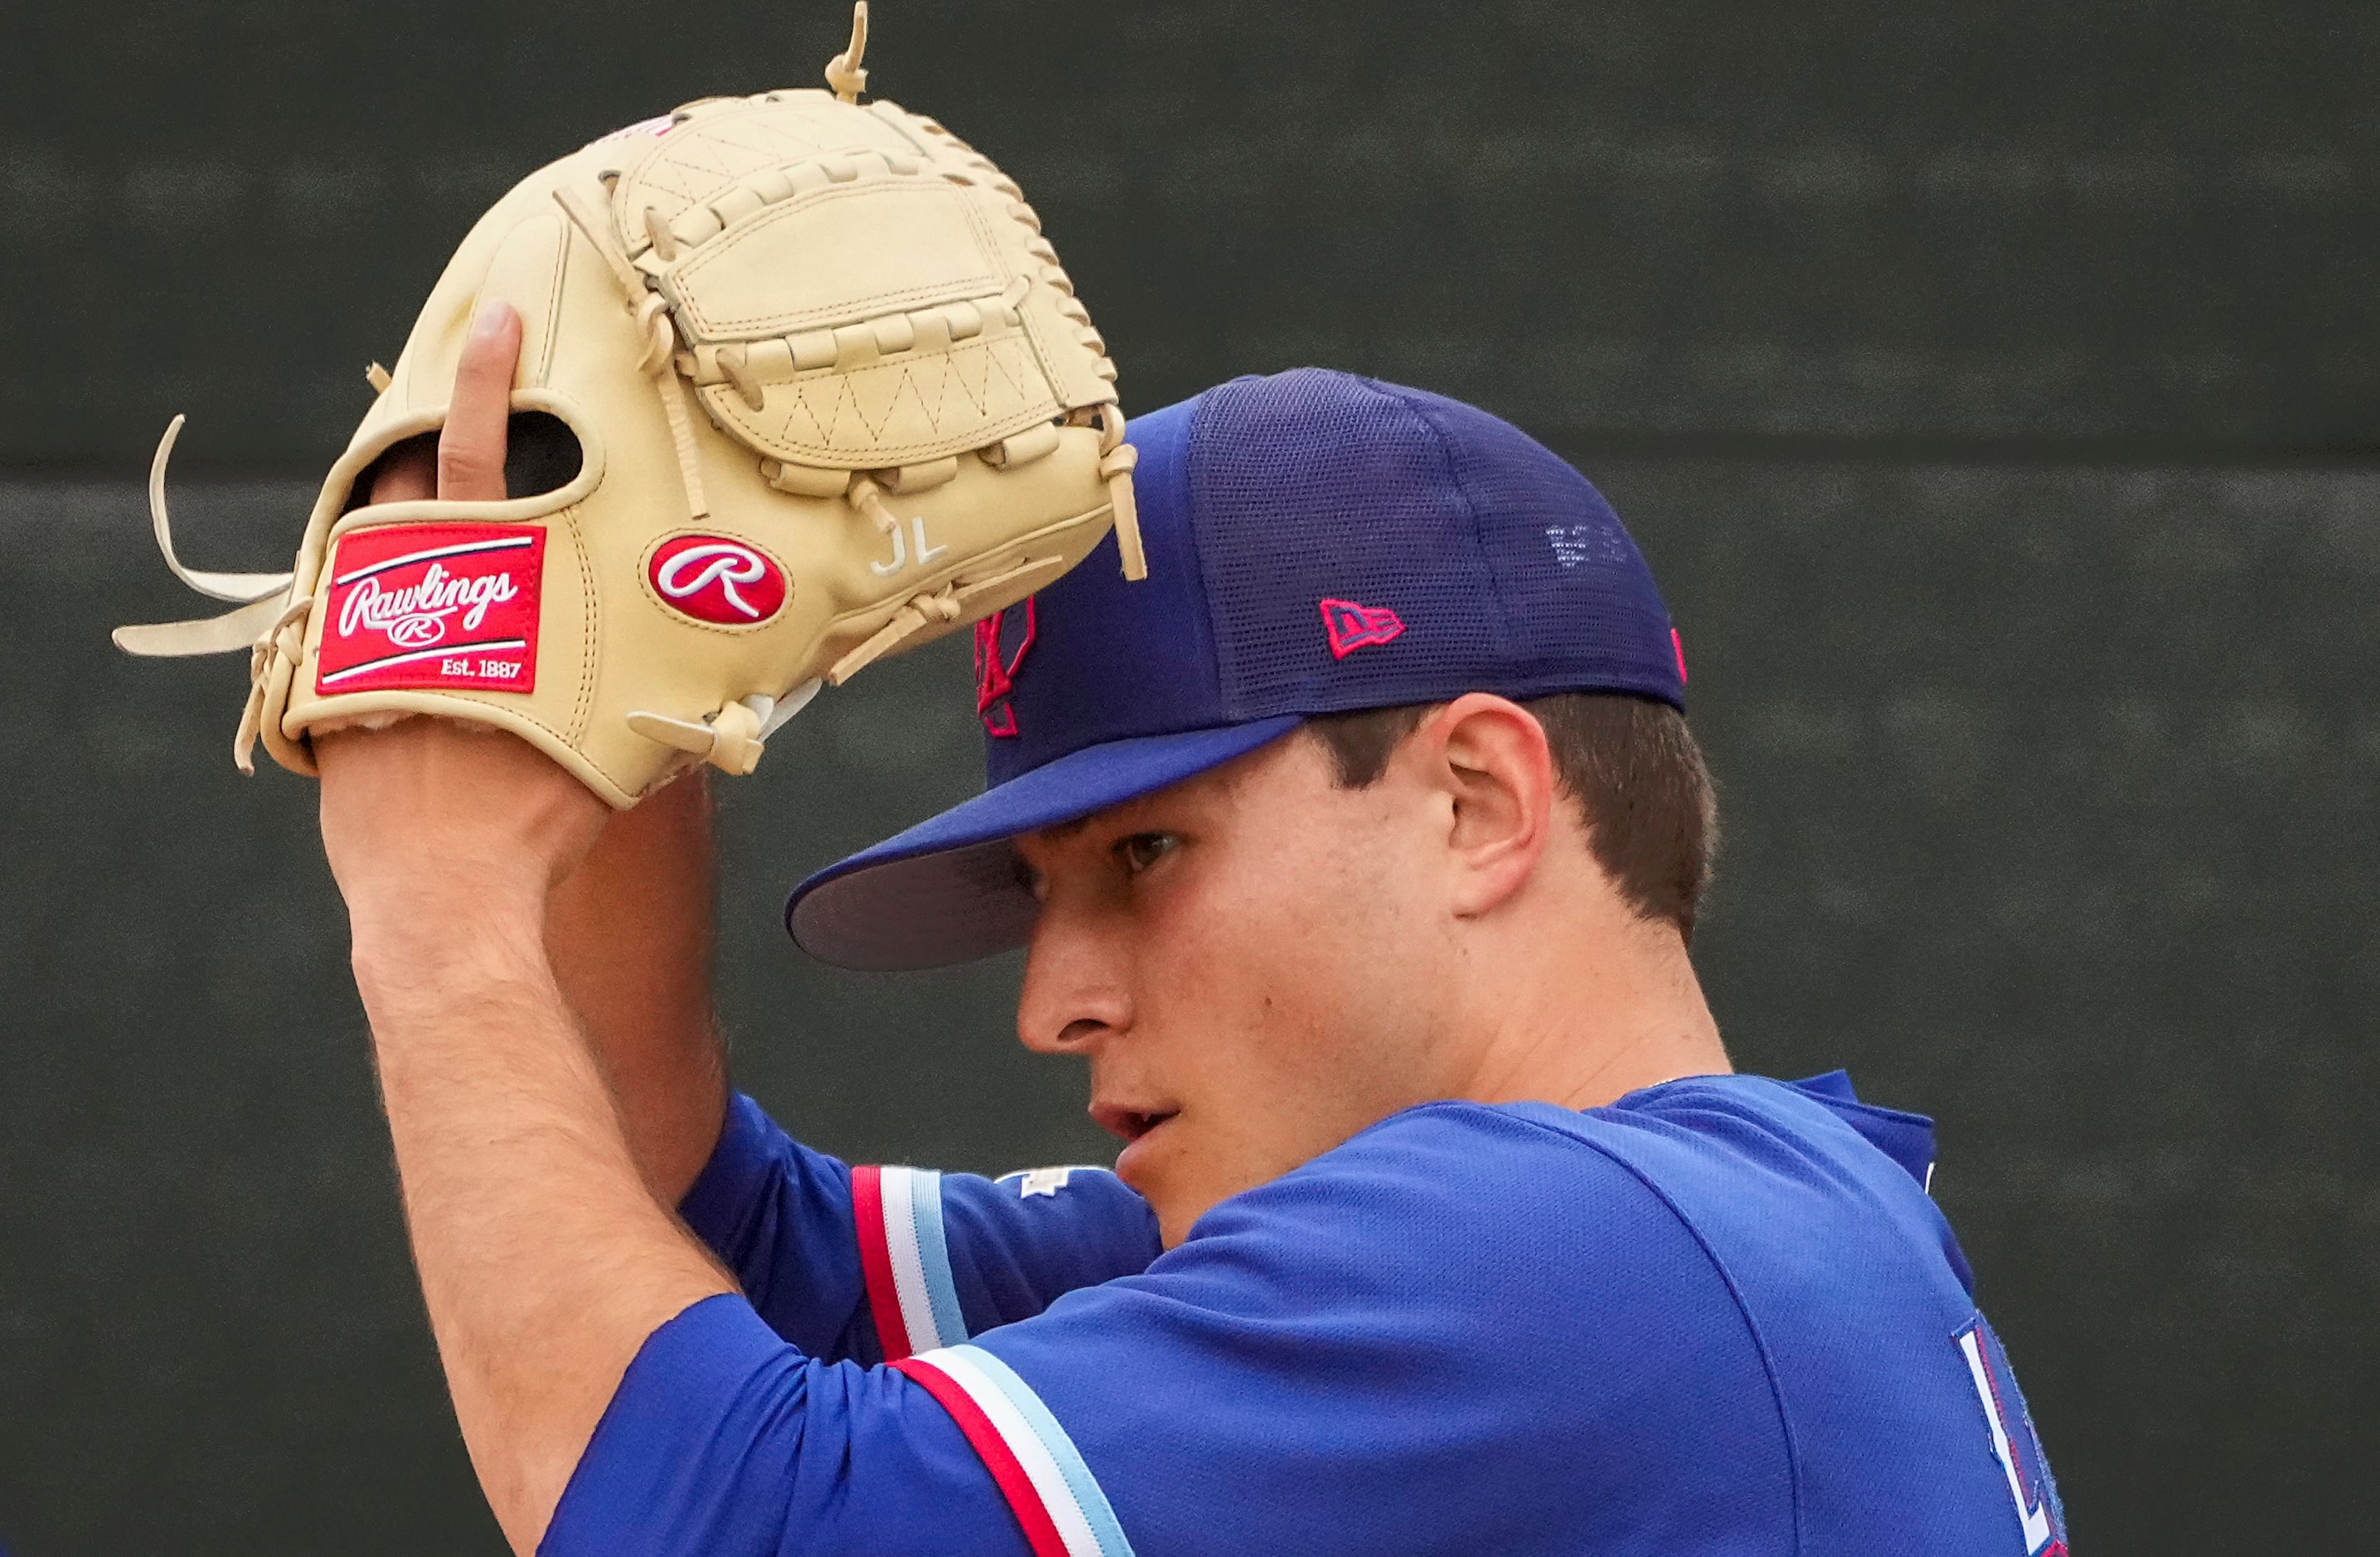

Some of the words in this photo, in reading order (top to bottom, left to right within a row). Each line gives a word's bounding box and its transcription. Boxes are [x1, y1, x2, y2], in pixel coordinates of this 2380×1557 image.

[870, 517, 948, 578] JL
[338, 563, 517, 637] Rawlings
[441, 658, 474, 677] Est.
[479, 659, 522, 679] 1887
